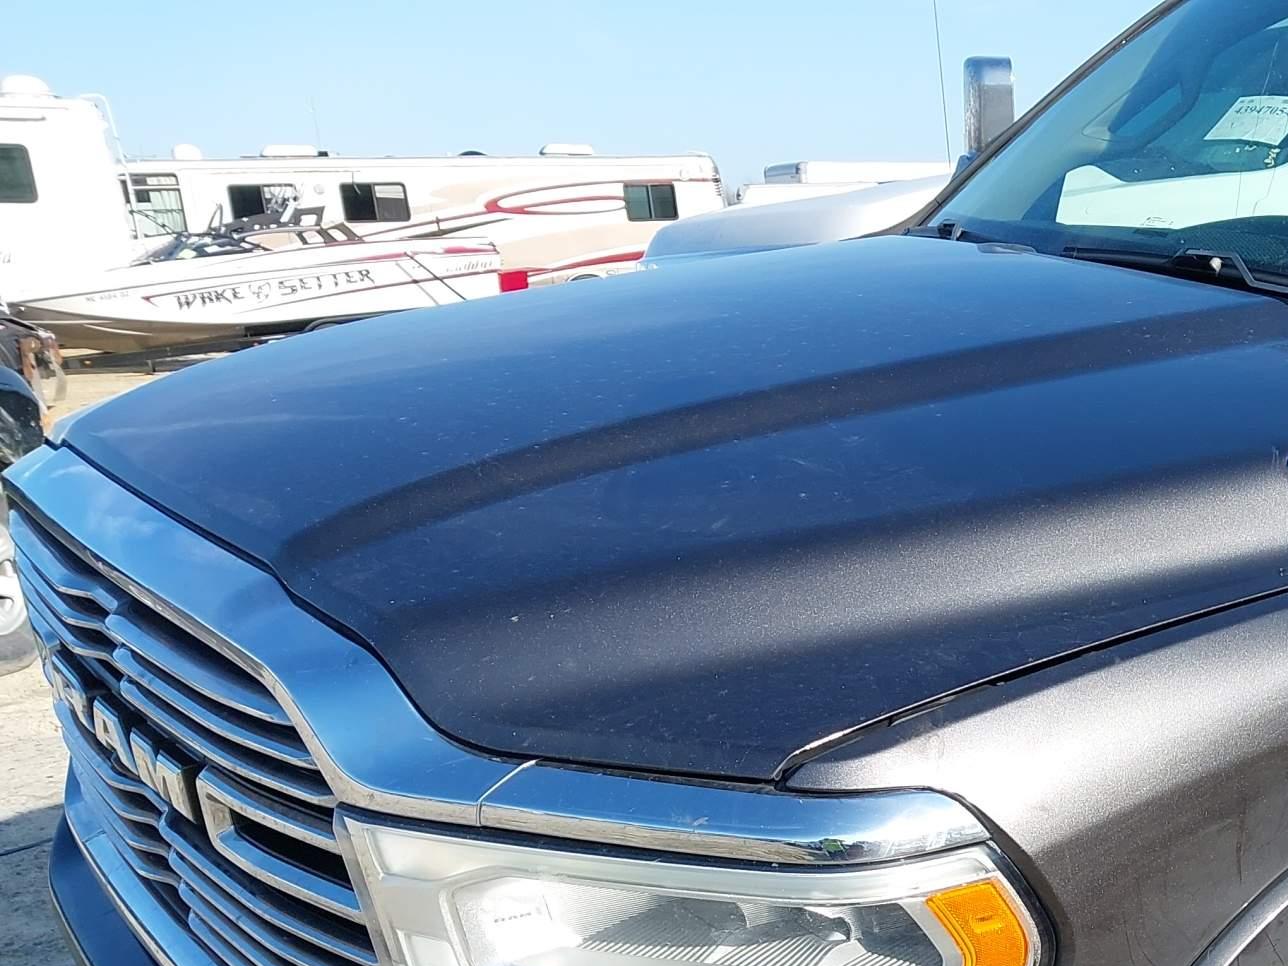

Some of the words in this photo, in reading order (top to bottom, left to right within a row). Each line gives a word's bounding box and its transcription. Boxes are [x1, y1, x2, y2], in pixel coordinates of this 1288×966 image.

[175, 286, 244, 311] WAKE
[278, 268, 376, 297] SETTER
[52, 654, 206, 824] RAM
